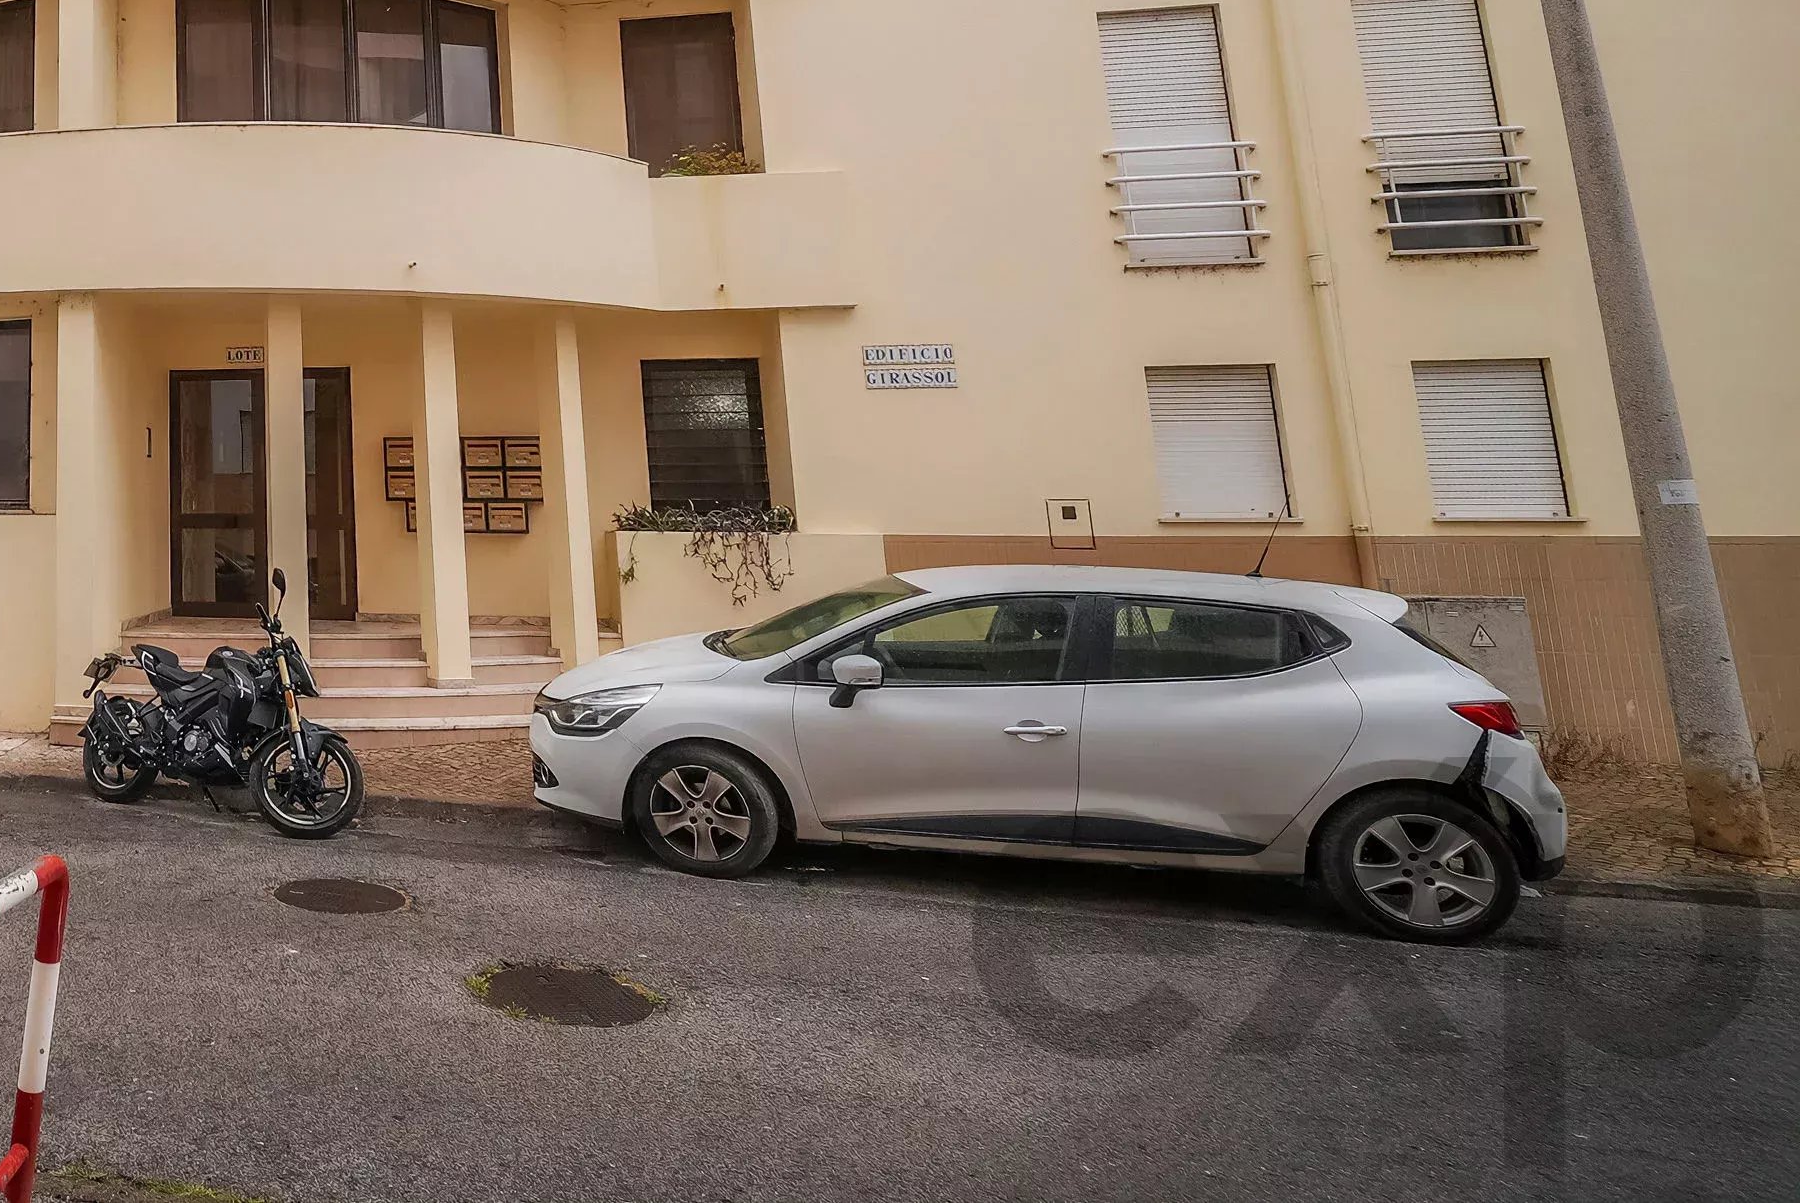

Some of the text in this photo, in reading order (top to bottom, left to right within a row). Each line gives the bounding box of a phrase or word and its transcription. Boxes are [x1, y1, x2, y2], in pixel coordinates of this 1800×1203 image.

[227, 349, 262, 361] LOTE
[864, 346, 953, 361] EDIFICIO
[866, 371, 957, 385] GIRASSOL
